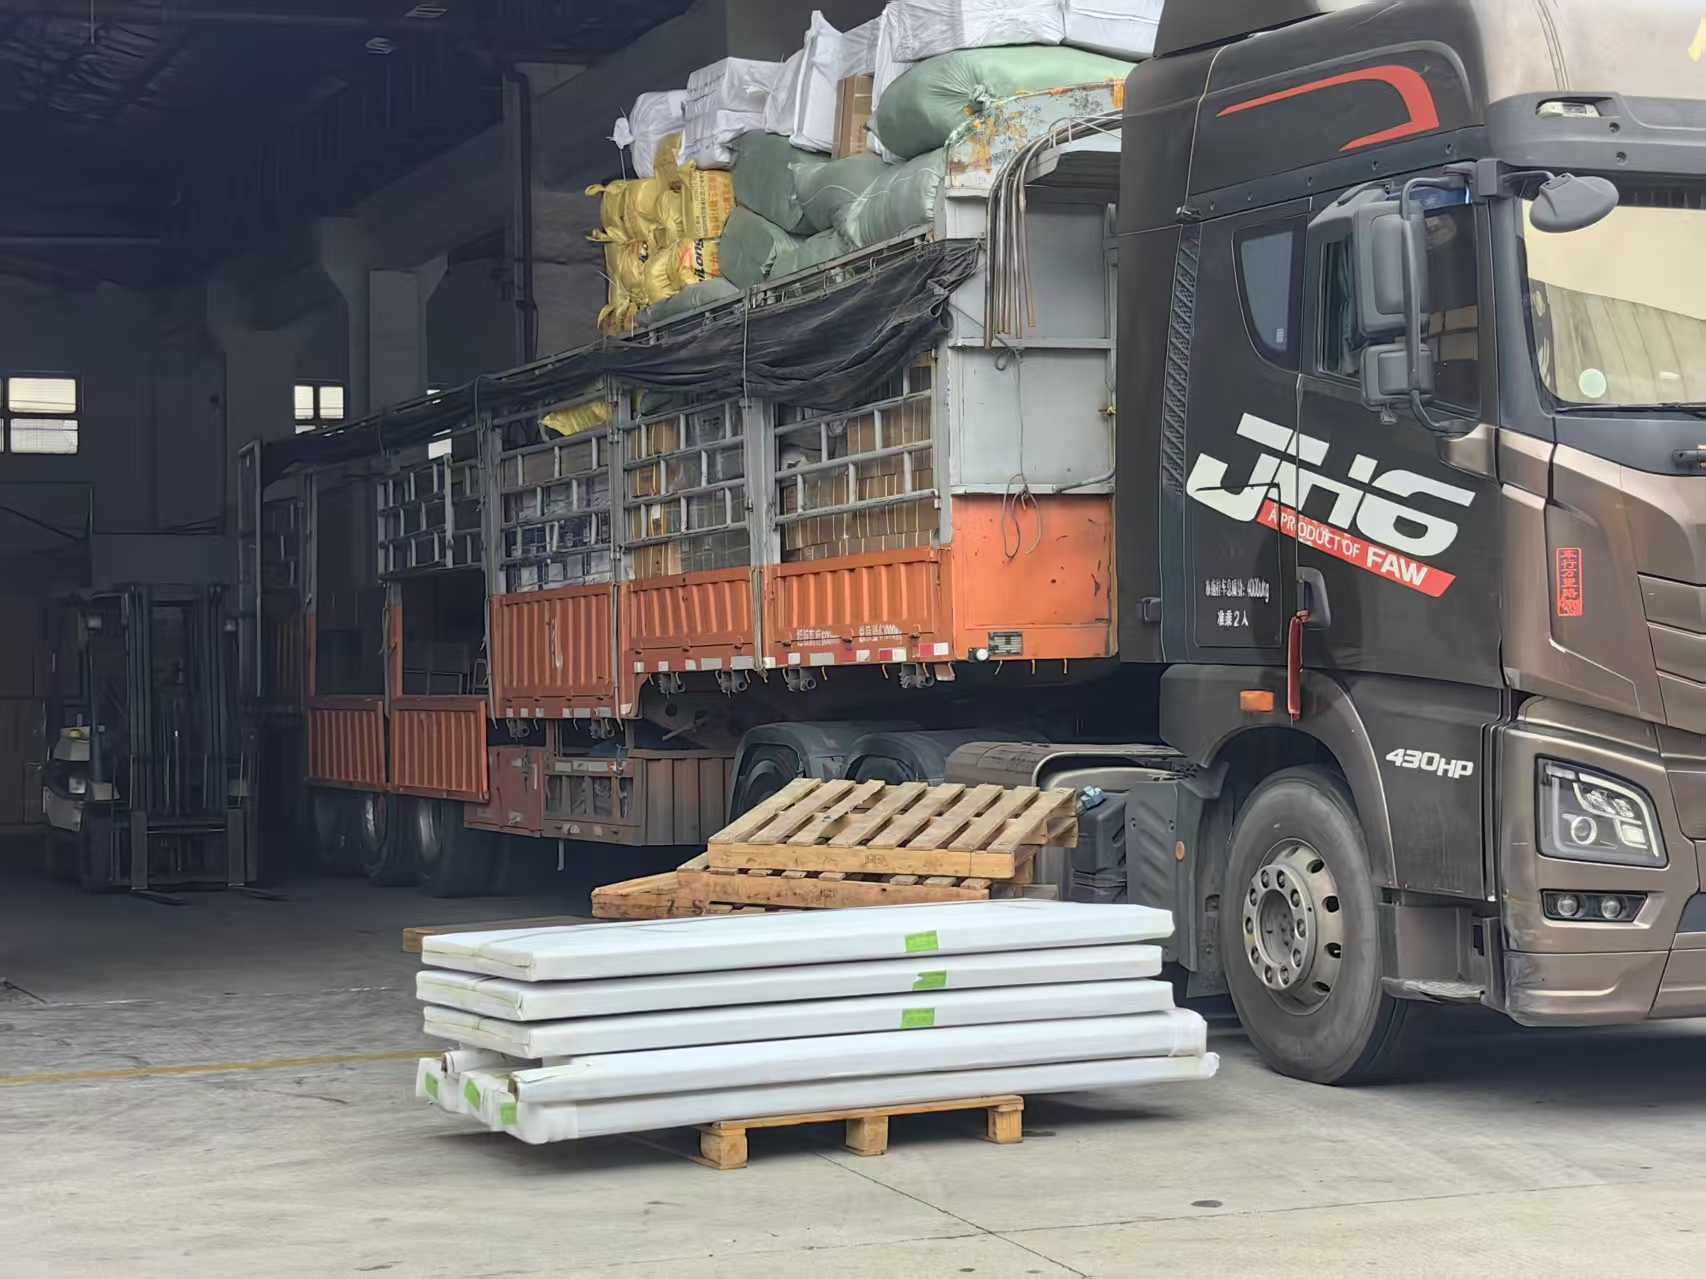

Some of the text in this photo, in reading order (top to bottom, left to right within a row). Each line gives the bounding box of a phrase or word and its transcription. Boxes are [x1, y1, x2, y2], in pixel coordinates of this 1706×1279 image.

[1268, 510, 1428, 587] A PRODUCT OF FAW
[1385, 748, 1474, 779] 430HP
